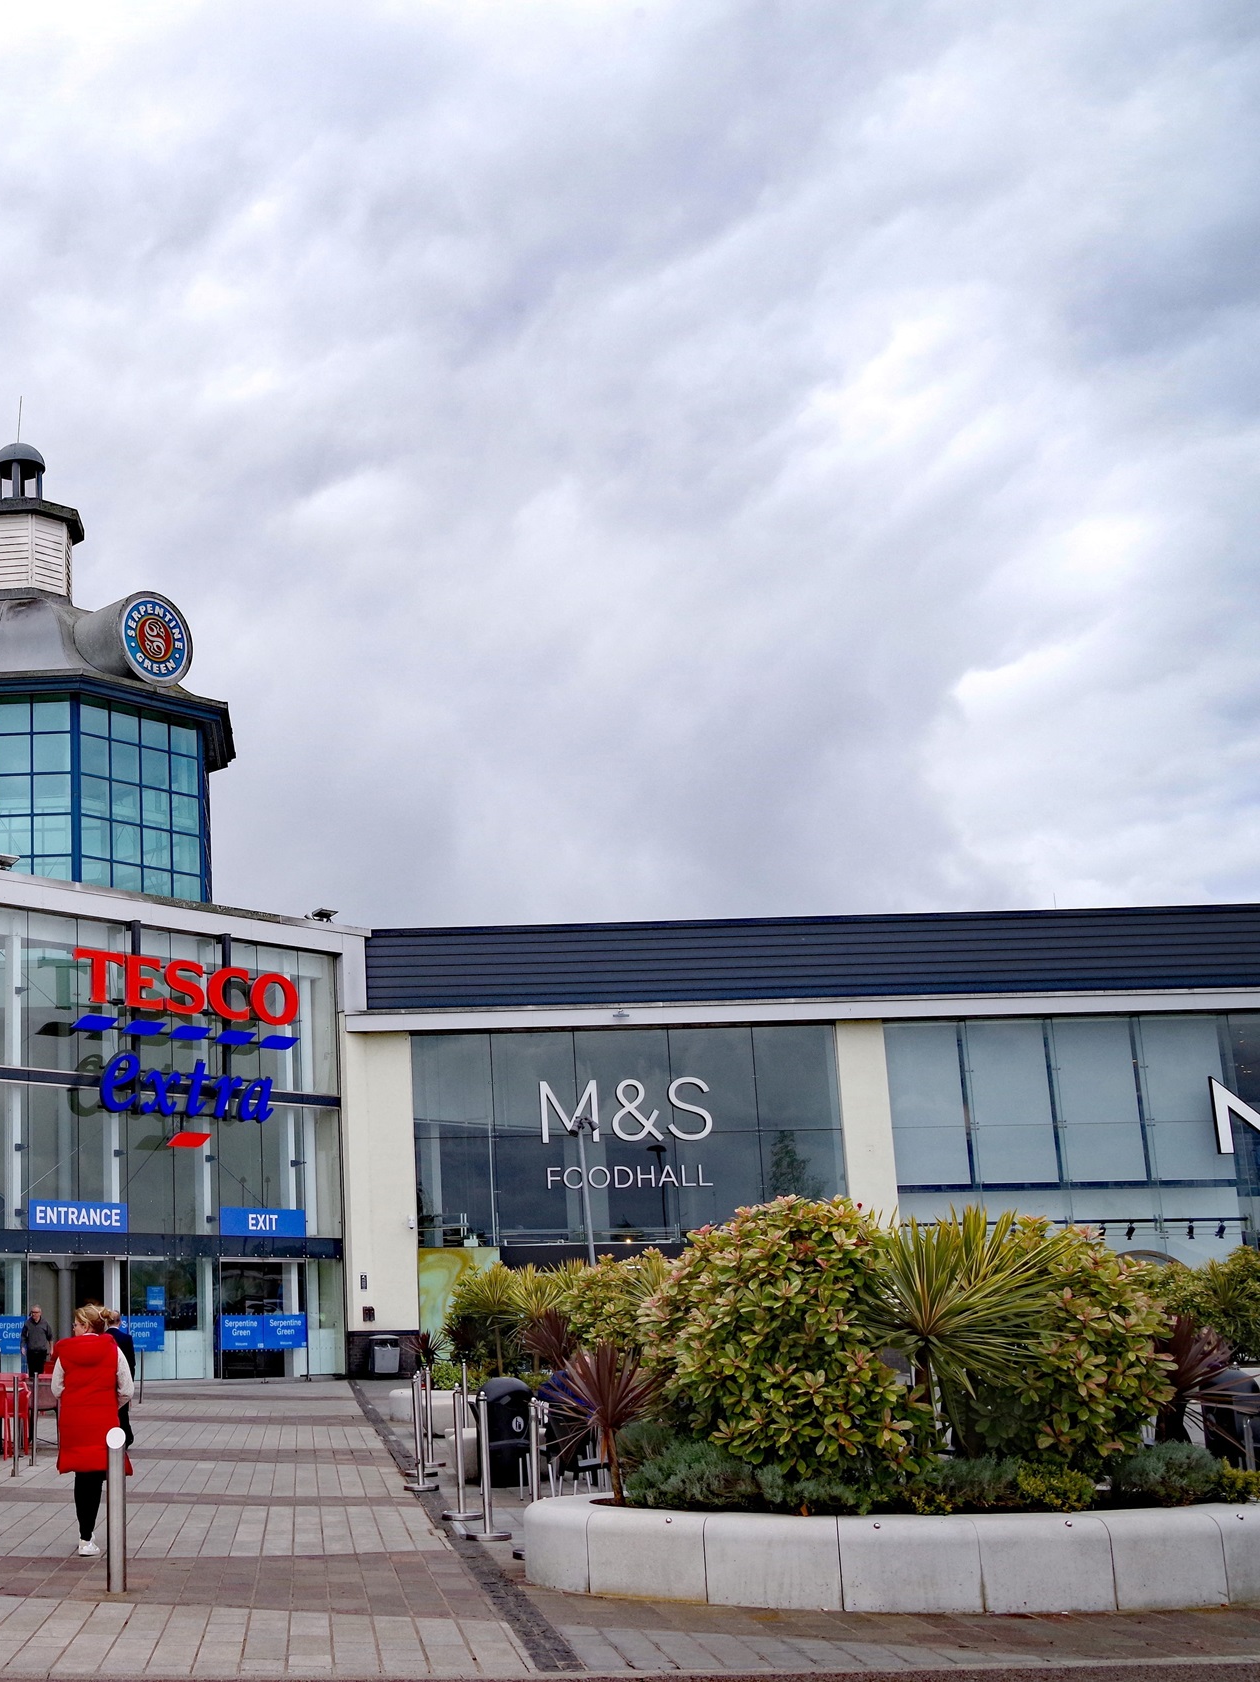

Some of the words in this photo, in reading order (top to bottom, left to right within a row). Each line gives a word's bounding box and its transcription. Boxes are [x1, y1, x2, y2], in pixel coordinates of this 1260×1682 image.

[127, 603, 183, 649] SERPENTINE
[136, 652, 176, 674] GREEN
[73, 947, 299, 1026] TESCO
[100, 1050, 274, 1123] extra
[539, 1076, 713, 1144] M&S
[546, 1164, 714, 1189] FOODHALL
[35, 1205, 121, 1227] ENTRANCE
[248, 1213, 279, 1231] EXIT
[2, 1330, 21, 1339] Gree
[224, 1320, 258, 1329] Serpentine
[232, 1328, 251, 1336] Green
[269, 1319, 302, 1328] Serpentine
[276, 1327, 295, 1336] Green
